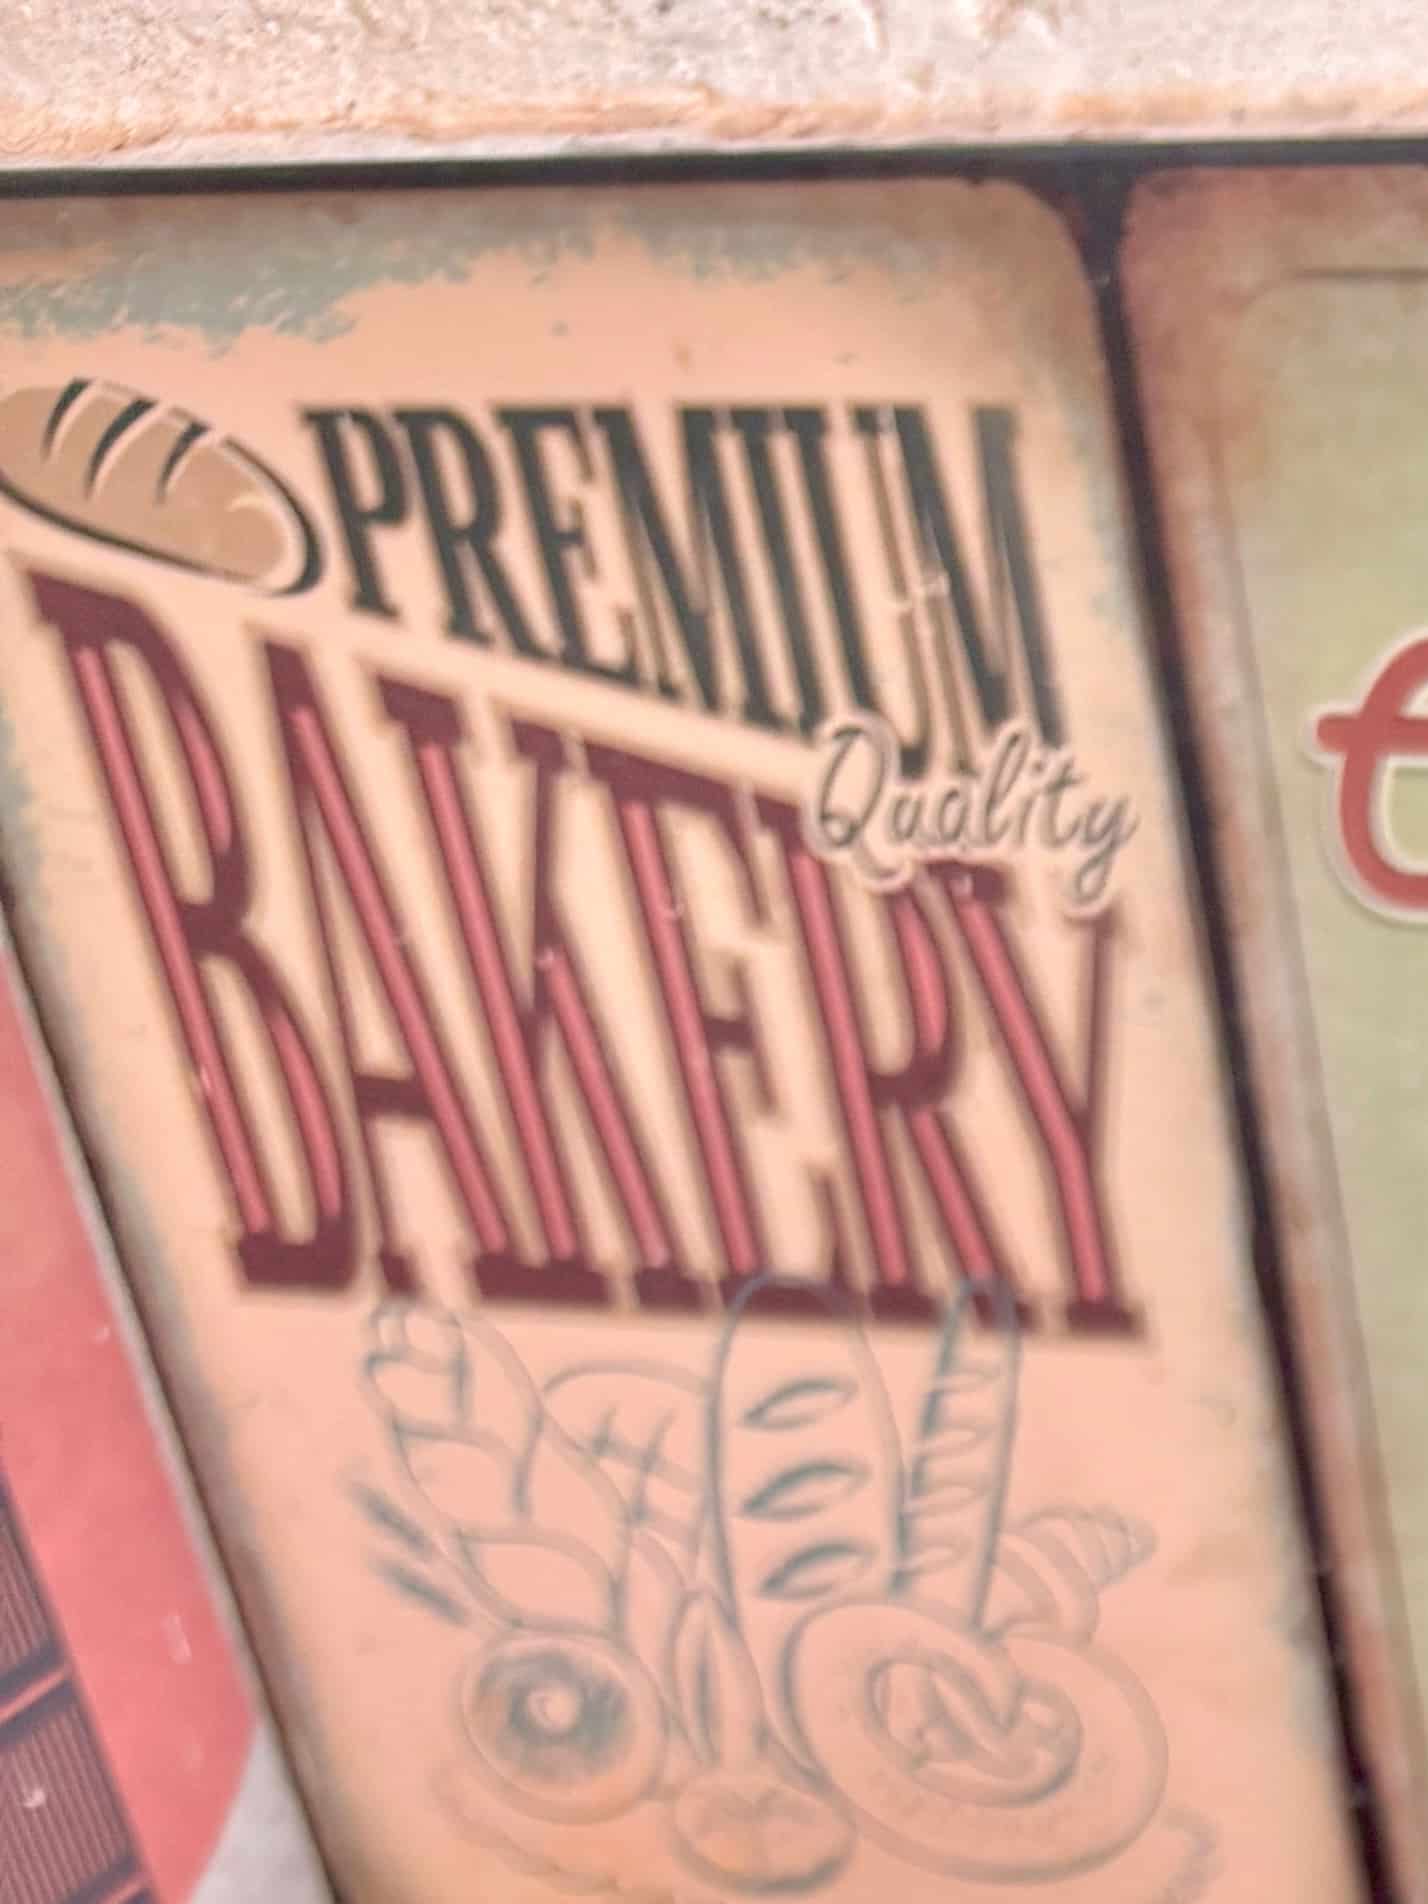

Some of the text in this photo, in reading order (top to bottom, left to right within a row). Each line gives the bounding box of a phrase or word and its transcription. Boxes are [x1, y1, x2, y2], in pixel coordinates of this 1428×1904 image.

[305, 402, 1064, 775] PREMIUM
[22, 568, 1138, 1332] BAKERY
[820, 724, 1134, 908] Quality
